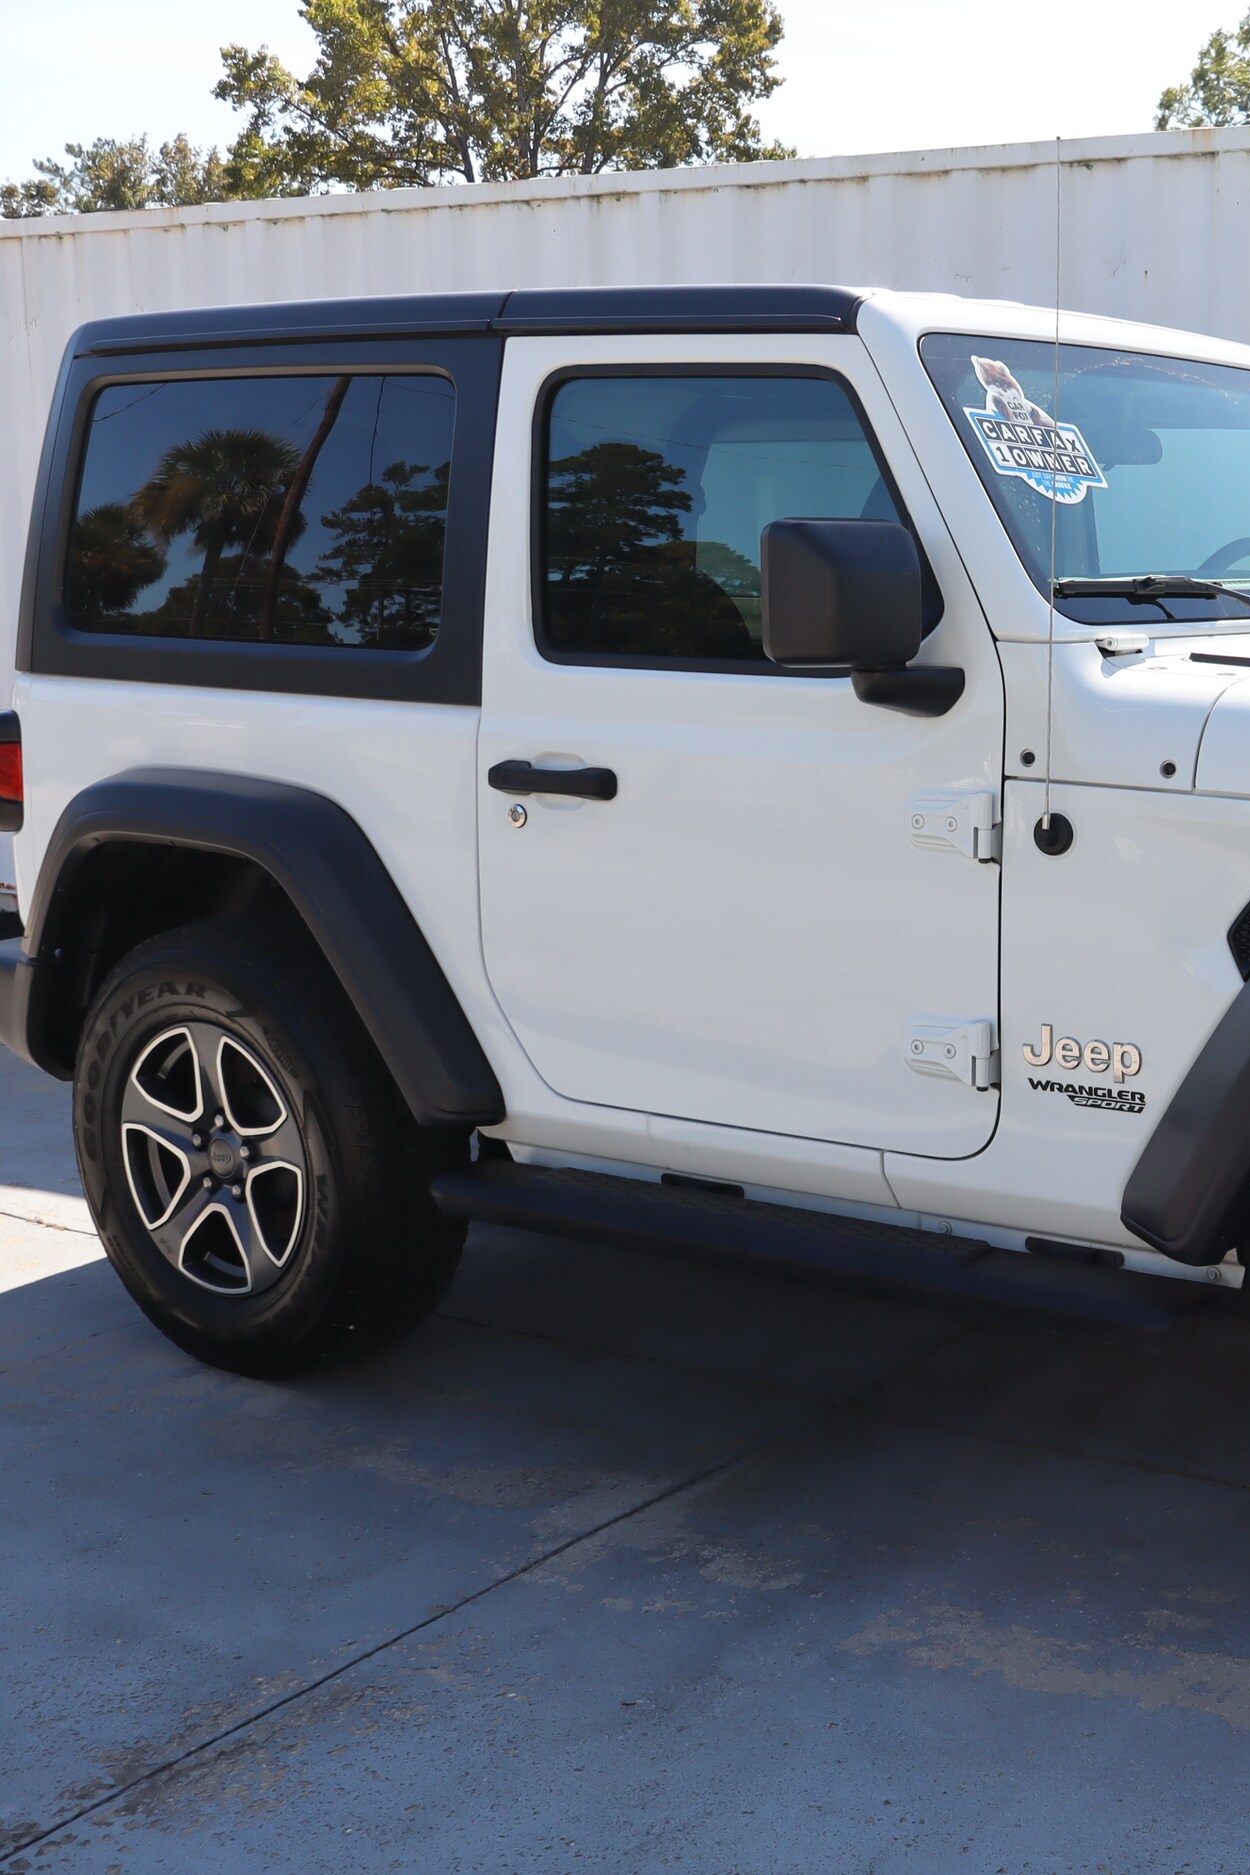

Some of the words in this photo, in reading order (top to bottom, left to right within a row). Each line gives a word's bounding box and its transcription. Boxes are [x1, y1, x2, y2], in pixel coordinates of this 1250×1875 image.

[1007, 401, 1024, 412] CAR
[981, 421, 1081, 453] CARFAX
[995, 445, 1010, 463] 1
[1011, 451, 1095, 475] OWNER
[1022, 1023, 1142, 1084] Jeep
[1027, 1077, 1146, 1103] WRANGLER
[1073, 1097, 1145, 1113] SPORT
